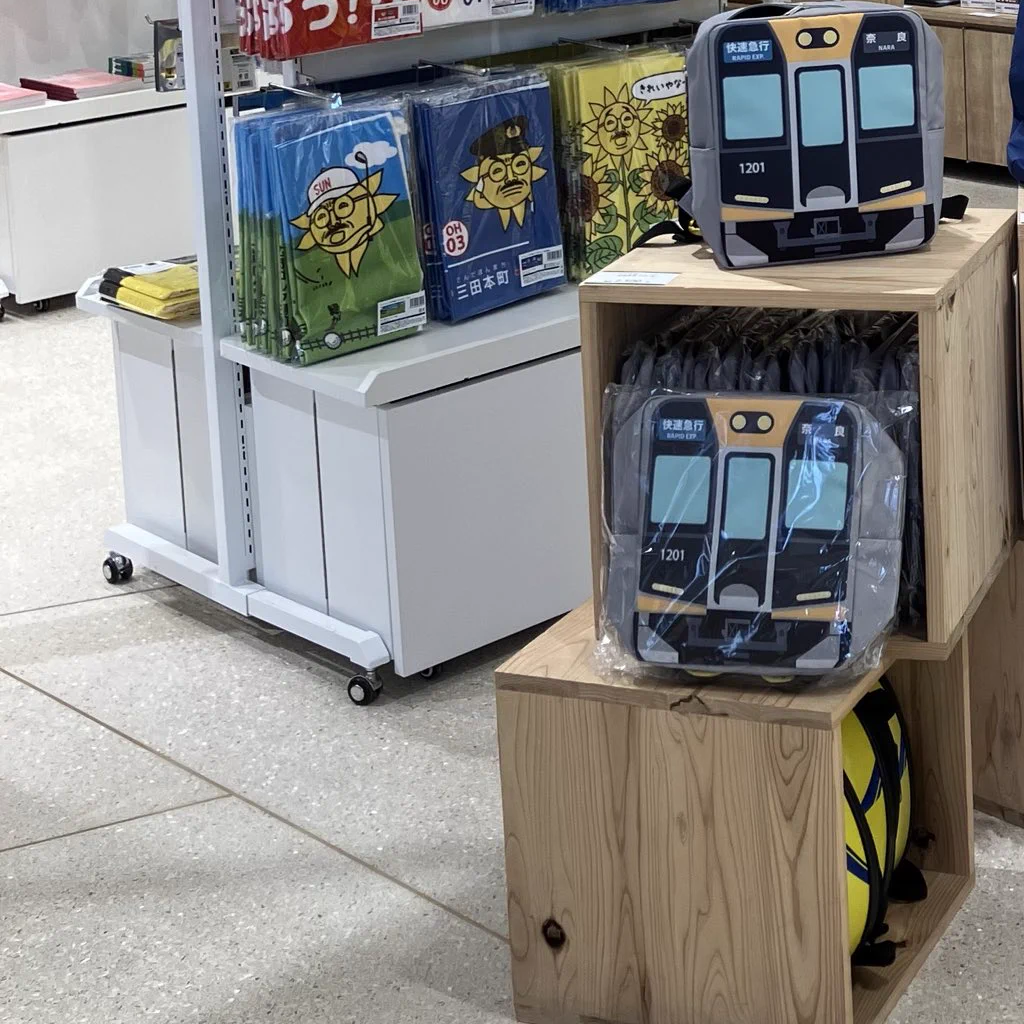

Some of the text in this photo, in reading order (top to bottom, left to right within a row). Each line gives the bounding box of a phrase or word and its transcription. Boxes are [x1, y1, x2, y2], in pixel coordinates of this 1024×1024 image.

[726, 40, 769, 54] 快速急行
[738, 161, 766, 174] 1201
[313, 176, 332, 196] SUN
[446, 223, 462, 237] OH
[446, 235, 466, 253] 03
[456, 270, 510, 300] 三田本町
[662, 418, 704, 432] 快速急行
[660, 548, 685, 561] 1201
